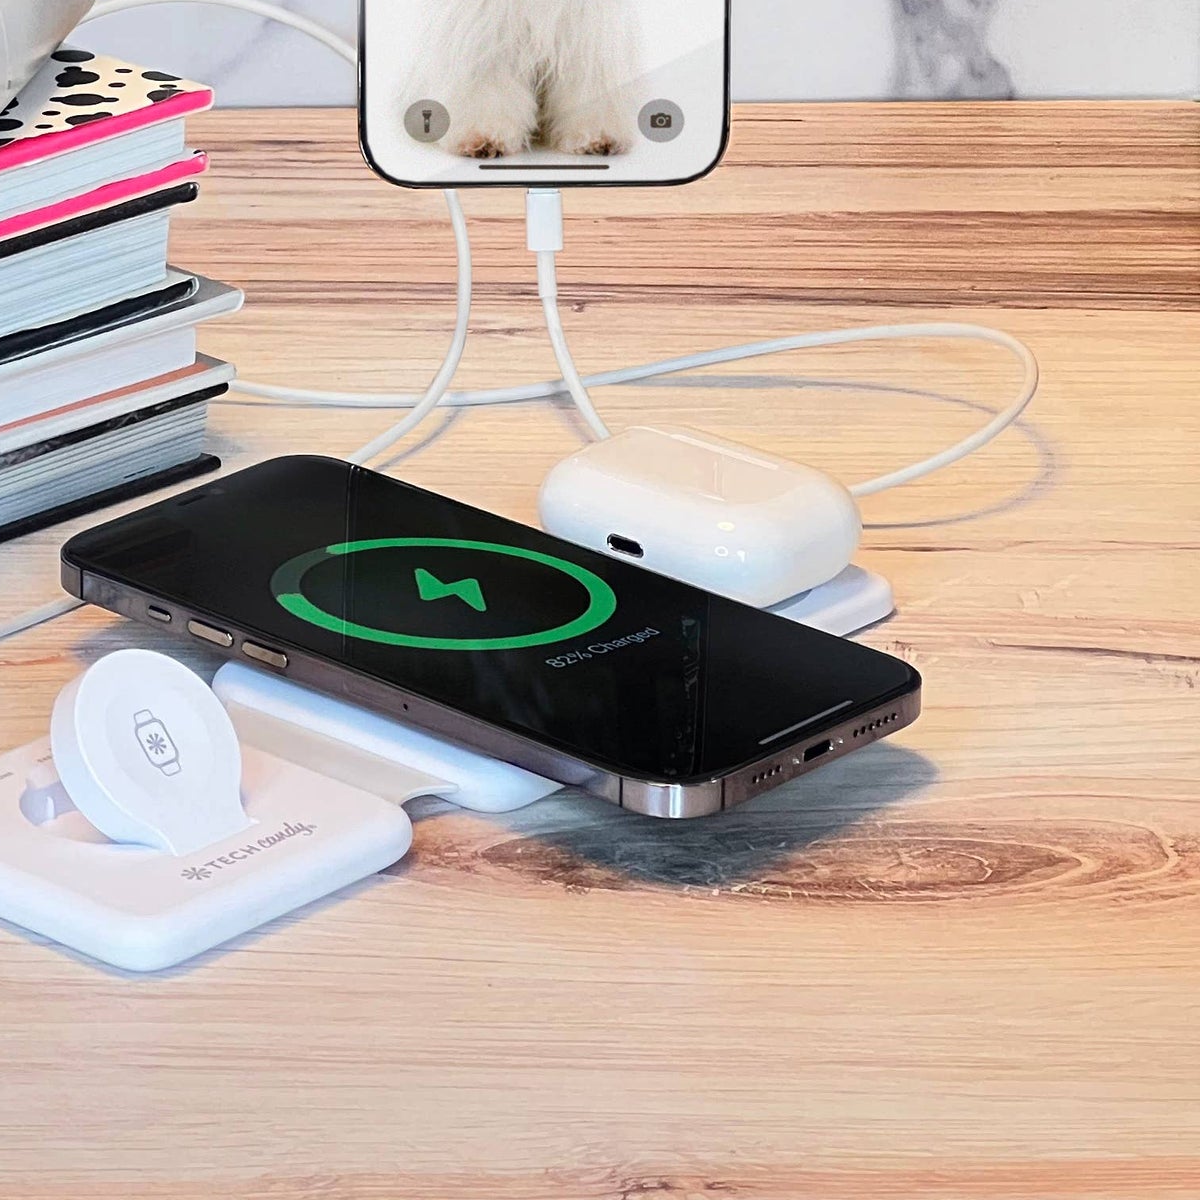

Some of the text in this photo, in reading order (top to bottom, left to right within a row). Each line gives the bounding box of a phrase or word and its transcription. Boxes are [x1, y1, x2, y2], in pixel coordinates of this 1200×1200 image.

[545, 627, 661, 668] 82% Charged
[203, 822, 313, 870] TECH candy
